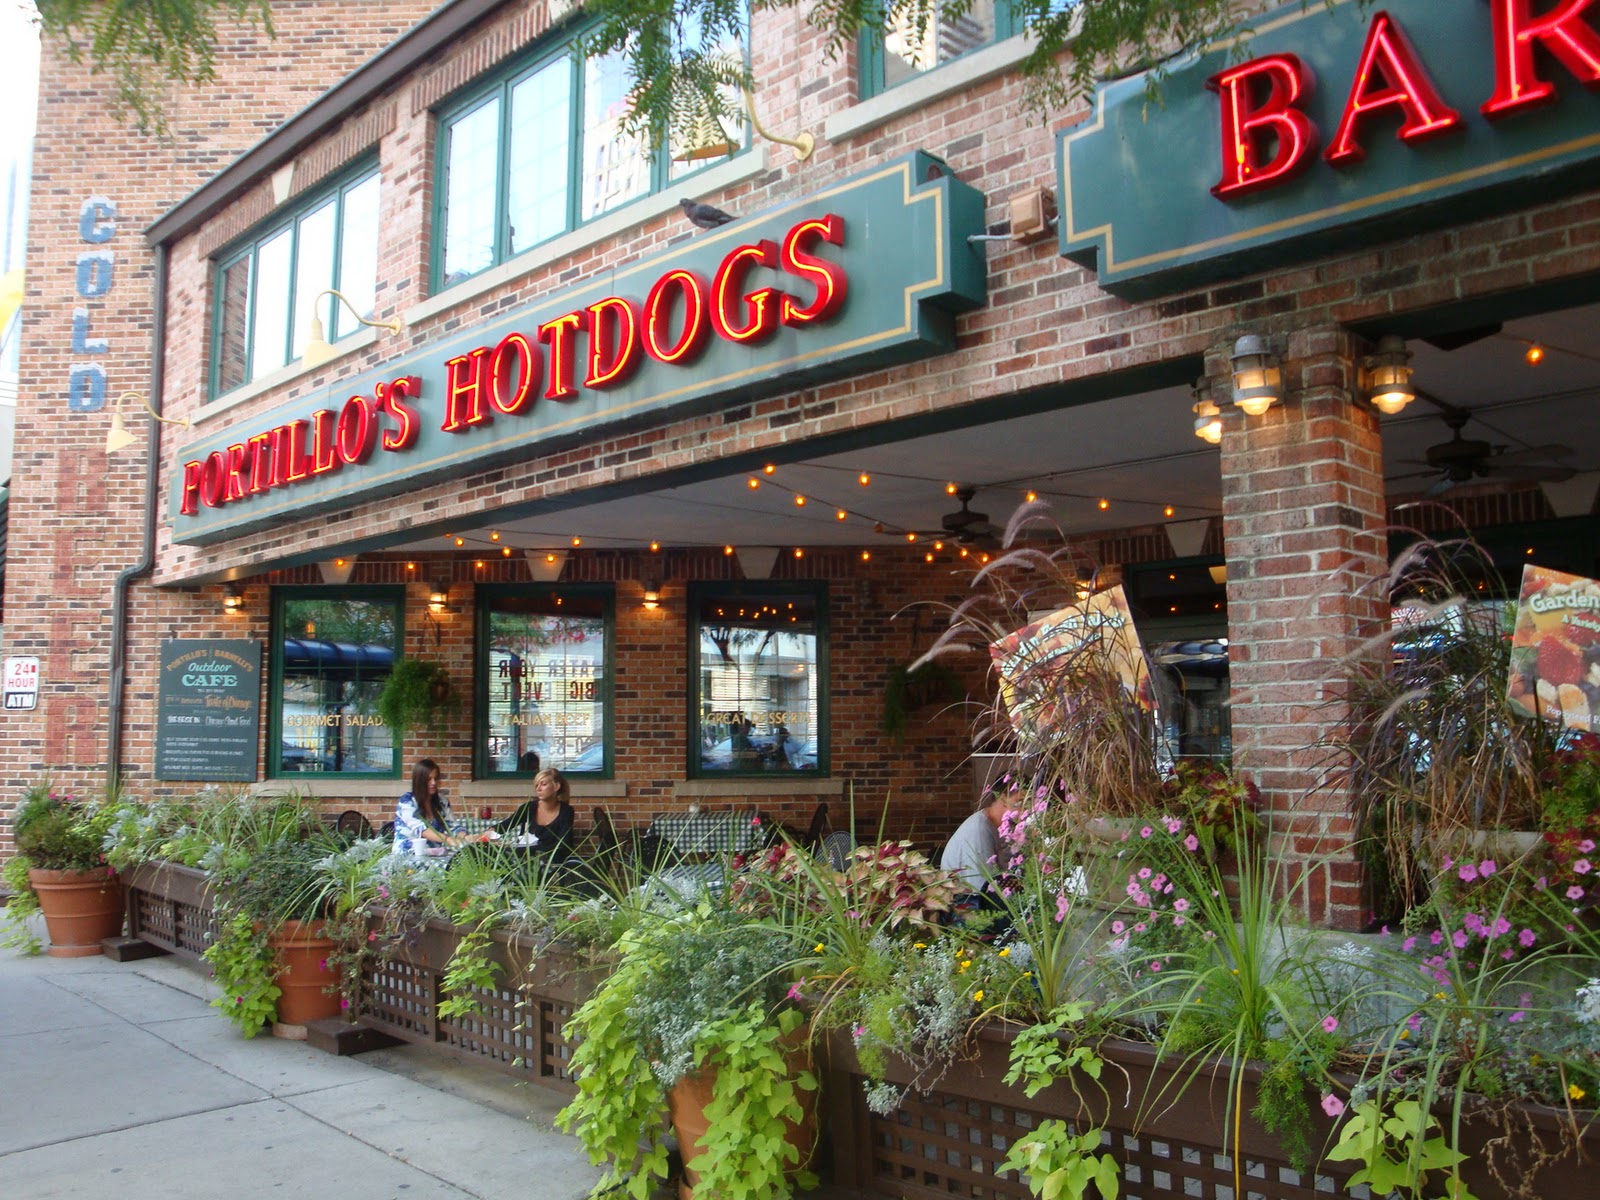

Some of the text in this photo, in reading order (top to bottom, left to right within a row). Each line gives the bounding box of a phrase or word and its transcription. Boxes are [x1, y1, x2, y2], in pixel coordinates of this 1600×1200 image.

[180, 213, 848, 515] PORTILLO'S HOTDOGS
[43, 194, 117, 767] COLD BEER
[1528, 589, 1600, 613] Garden
[15, 663, 29, 675] 24
[187, 660, 232, 673] Outdoor
[8, 678, 35, 688] HOUR
[181, 674, 238, 687] CAFE
[6, 694, 34, 708] ATM
[287, 714, 386, 726] GOURMET SALAD
[501, 714, 552, 726] ITALIAN
[706, 711, 812, 725] GREAT DESSERTS
